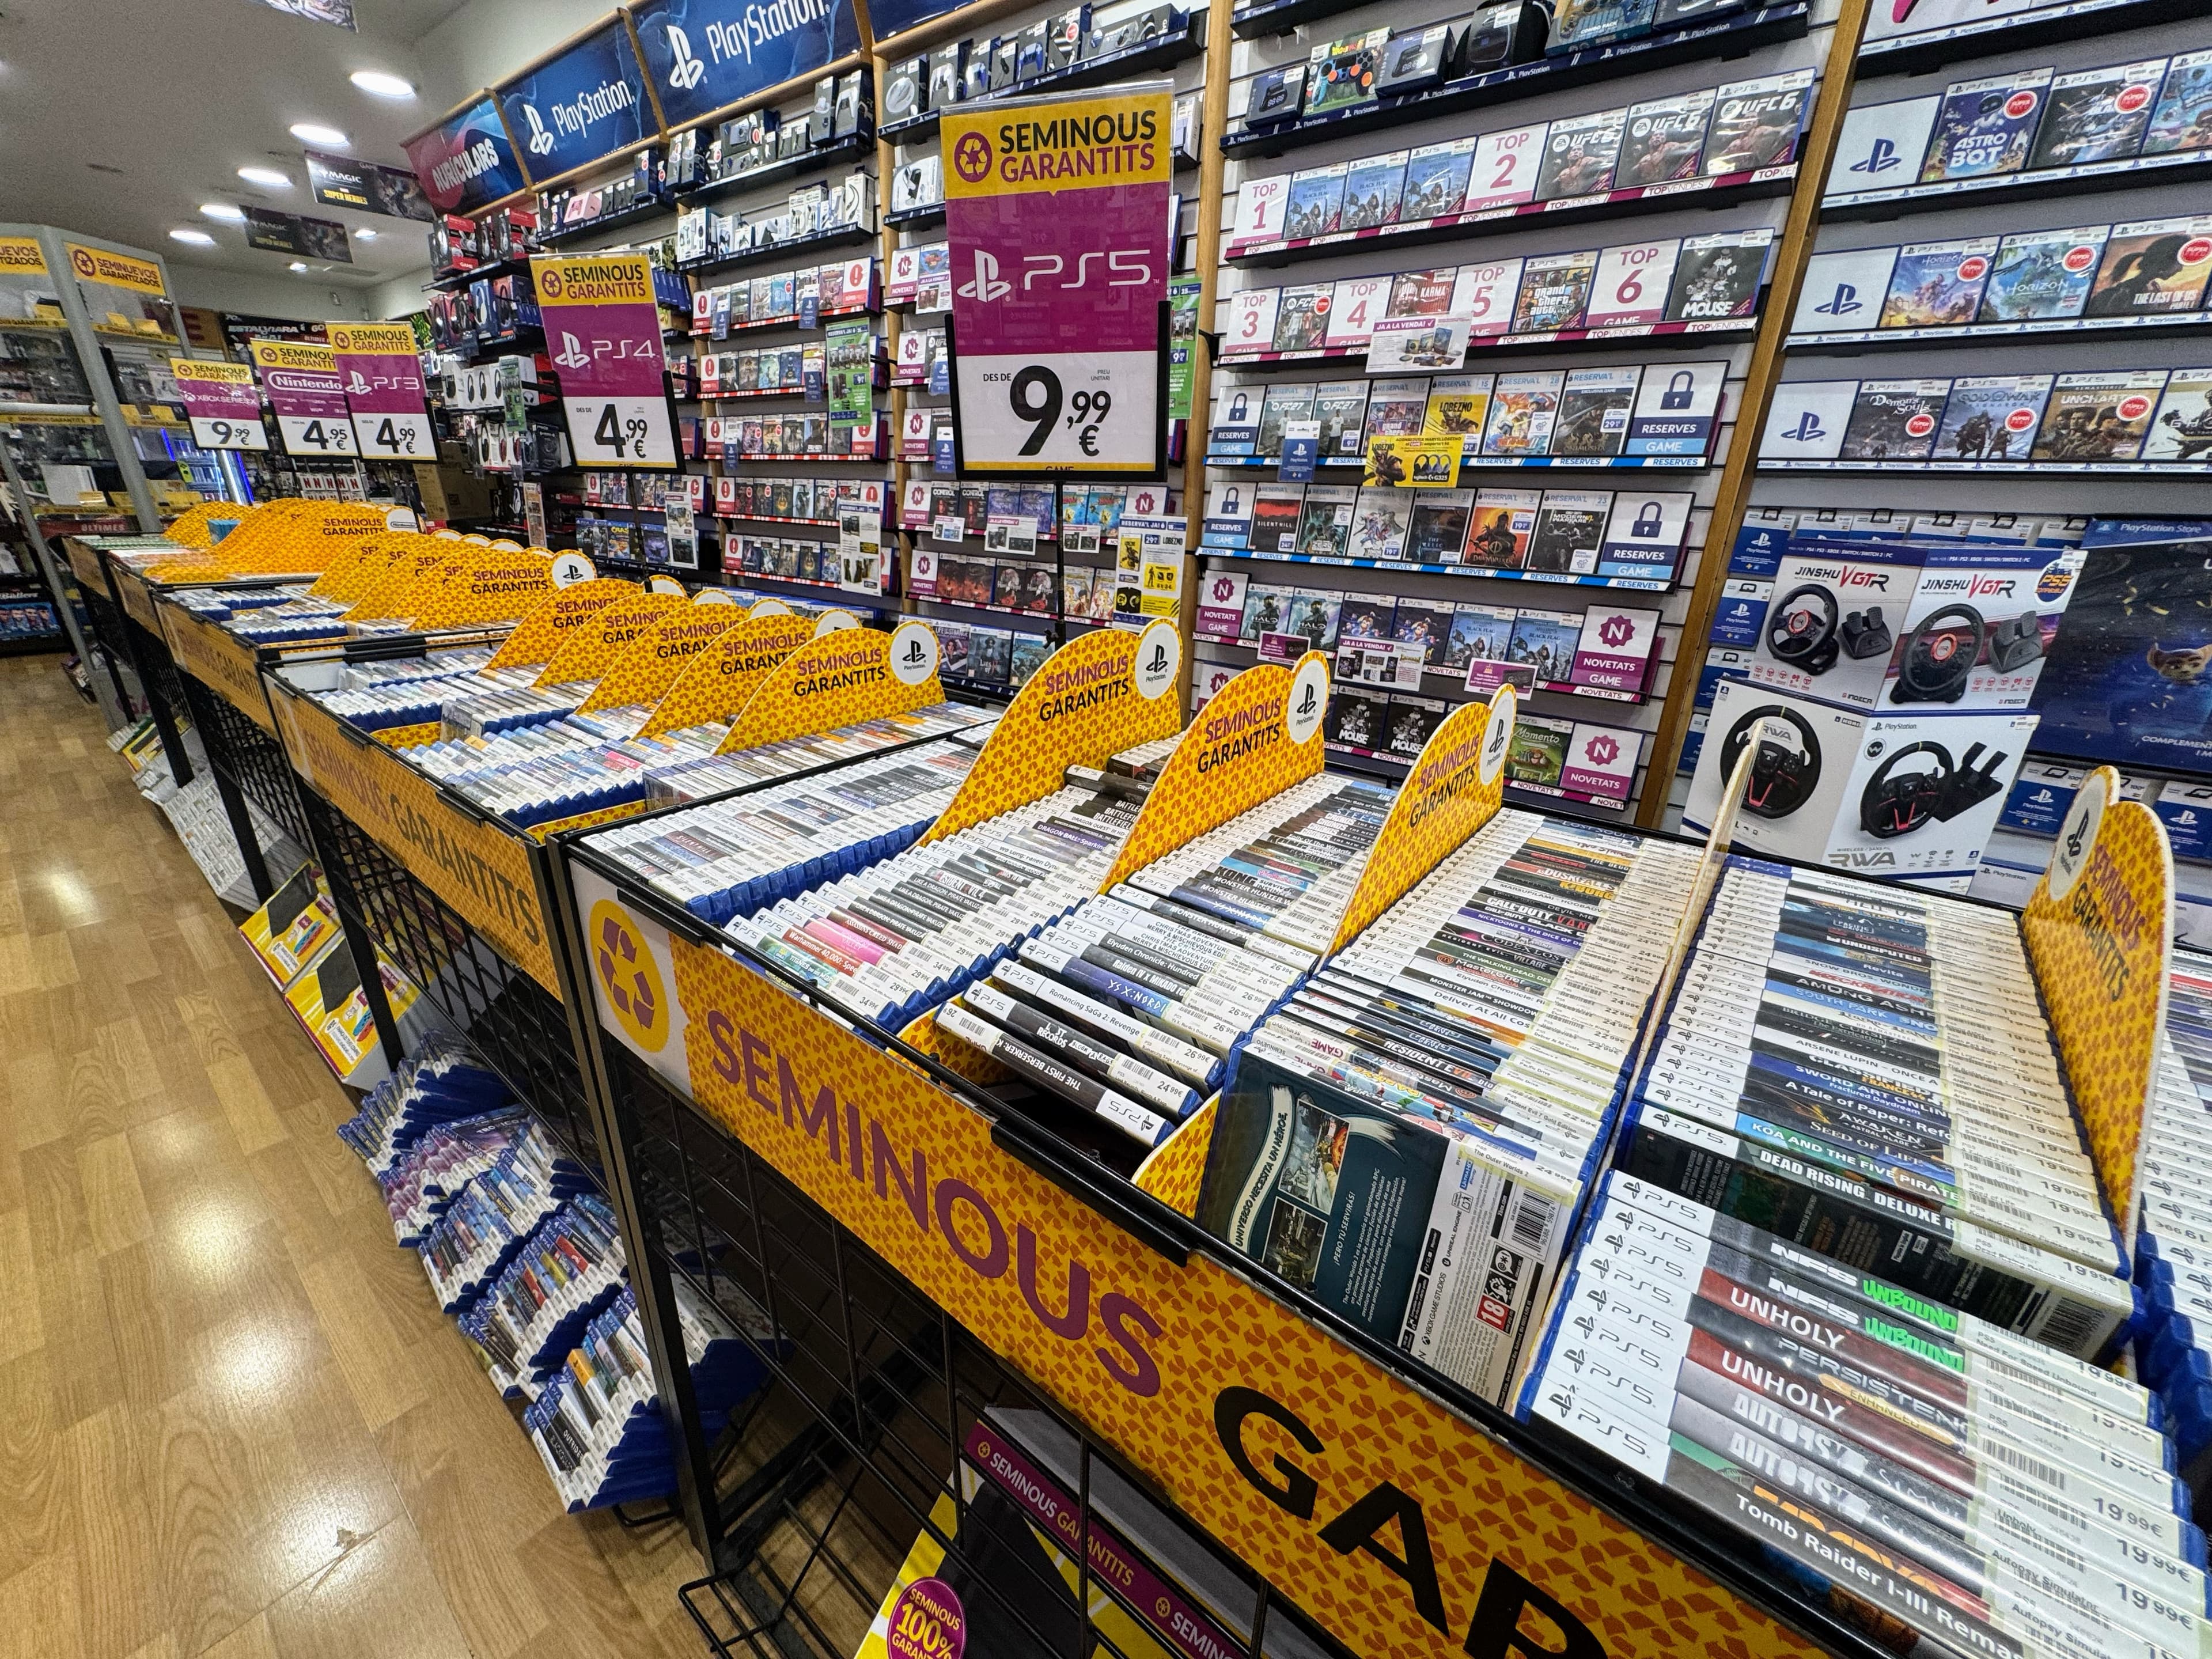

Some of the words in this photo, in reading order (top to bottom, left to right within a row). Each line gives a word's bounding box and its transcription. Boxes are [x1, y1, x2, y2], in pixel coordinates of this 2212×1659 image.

[706, 0, 825, 65] PlayStation
[552, 80, 632, 139] PlayStation
[1354, 104, 1379, 116] PlayStation
[999, 111, 1156, 154] SEMINOUS
[1495, 132, 1529, 151] TOP
[1955, 132, 2008, 150] ASTRO
[432, 139, 499, 192] AURICULARS
[1000, 143, 1154, 183] GARANTITS
[1950, 146, 2002, 168] BOT
[329, 169, 361, 184] MAGIC
[1490, 154, 1517, 188] 2
[1253, 183, 1277, 198] TOP
[1253, 200, 1266, 229] 1
[97, 259, 158, 279] SEMINUEVOS
[1620, 248, 1659, 266] TOP
[100, 268, 160, 287] GARANTIZADOS
[563, 264, 643, 283] SEMINOUS
[1024, 250, 1150, 290] PS5
[1474, 267, 1505, 283] TOP
[567, 282, 646, 300] GARANTITS
[1350, 283, 1377, 297] TOP
[1535, 285, 1565, 297] grand
[1616, 269, 1643, 304] 6
[2134, 293, 2149, 305] THE
[2150, 292, 2172, 304] LAST
[1244, 295, 1266, 307] TOP
[1472, 286, 1493, 317] 5
[1535, 295, 1569, 306] theft
[1681, 301, 1734, 318] MOUSE
[1241, 310, 1259, 338] 3
[1347, 300, 1367, 328] 4
[351, 330, 408, 341] SEMINOUS
[354, 340, 410, 351] GARANTITS
[592, 340, 656, 359] PS4
[194, 365, 247, 374] SEMINOUS
[983, 373, 999, 381] DES
[1000, 373, 1011, 381] DE
[276, 377, 342, 391] Nintendo
[373, 377, 419, 389] PS3
[1440, 402, 1472, 412] LOBEZNO
[1217, 431, 1249, 440] RESERVES
[1642, 424, 1696, 434] RESERVES
[1219, 444, 1241, 453] GAME
[1646, 442, 1683, 452] GAME
[1653, 458, 1698, 466] RESERVES
[324, 518, 382, 527] SEMINOUS
[474, 567, 544, 582] SEMINOUS
[1794, 566, 1841, 578] JINSHU
[1921, 578, 1970, 590] JINSHU
[471, 579, 548, 594] GARANTITS
[1204, 611, 1236, 621] NOVETATS
[1251, 615, 1278, 623] HALO
[724, 632, 807, 656] SEMINOUS
[797, 648, 882, 676] SEMINOUS
[904, 664, 926, 672] PlayStation
[1584, 658, 1635, 671] NOVETATS
[794, 665, 885, 696] GARANTITS
[1046, 654, 1128, 696] SEMINOUS
[1146, 673, 1166, 683] PlayStation
[1039, 677, 1129, 721] GARANTITS
[1581, 688, 1622, 699] NOVETATS
[1205, 697, 1281, 744] SEMINOUS
[1198, 722, 1280, 773] GARANTITS
[1339, 729, 1369, 744] MOUSE
[1418, 734, 1480, 793] SEMINOUS
[1409, 762, 1476, 828] GARANTITS
[390, 793, 540, 946] GARANTITS
[2090, 843, 2146, 951] SEMINOUS
[1478, 913, 1519, 929] NICKTOONS
[789, 931, 822, 956] Warhammer
[821, 948, 843, 965] 40,000:
[1141, 933, 1177, 950] CHRISTMAS
[1177, 948, 1218, 967] ADVENTURE
[1841, 938, 1922, 963] UNDISPUTED
[2074, 881, 2131, 1002] GARANTITS
[1107, 938, 1133, 953] Eiyuden
[1134, 948, 1168, 968] Chronicle:
[1168, 963, 1199, 980] Hundred
[1463, 952, 1476, 960] THE
[1475, 955, 1512, 972] WALKING
[1512, 967, 1533, 979] DEAD:
[1112, 960, 1135, 975] Raiden
[1136, 968, 1143, 979] IV
[1151, 975, 1177, 994] MIKADO
[1796, 978, 1874, 1002] AMONG
[1049, 988, 1084, 1011] Romancing
[1084, 1004, 1103, 1018] SaGa
[1103, 1013, 1109, 1021] 2:
[1110, 1016, 1141, 1036] Revenge
[1434, 991, 1473, 1009] Deliver
[1475, 1005, 1488, 1014] At
[1490, 1009, 1507, 1021] All
[1796, 988, 1843, 1006] SOUTH
[1848, 1002, 1889, 1018] PARK
[1037, 1027, 1069, 1048] RECORDS
[1002, 1042, 1046, 1071] BERSERKER:
[1796, 1039, 1840, 1056] ARSENE
[1843, 1053, 1878, 1067] LUPIN
[1048, 1064, 1066, 1083] FIRST
[1067, 1075, 1081, 1091] THE
[1795, 1065, 1854, 1088] SWORD
[1858, 1085, 1889, 1099] ART
[1830, 1082, 1870, 1100] Fractured
[1872, 1094, 1921, 1116] Daydream
[1753, 1122, 1784, 1140] KOA
[1788, 1135, 1823, 1153] AND
[1827, 1148, 1856, 1165] THE
[1860, 1156, 1895, 1178] FIVE
[1234, 1199, 1253, 1247] UNIVERSO
[1251, 1162, 1274, 1201] NECESITA
[1268, 1145, 1278, 1162] UN
[1759, 1149, 1802, 1176] DEAD
[1806, 1166, 1866, 1199] RISING
[1874, 1192, 1941, 1225] DELUXE
[707, 1010, 1164, 1397] SEMINOUS
[1342, 1191, 1355, 1230] SERVIRÁS!
[1770, 1242, 1858, 1287] NFS
[1862, 1279, 1959, 1333] UNBOUND
[1730, 1286, 1846, 1350] UNHOLY
[1721, 1349, 1846, 1423] UNHOLY
[1850, 1389, 1919, 1429] ENHANCED
[990, 1452, 1058, 1518] SEMINOUS
[1736, 1494, 1801, 1541] Tomb
[1803, 1521, 1880, 1585] Raider
[1887, 1580, 1930, 1615] I-III
[909, 1587, 961, 1631] SEMINOUS
